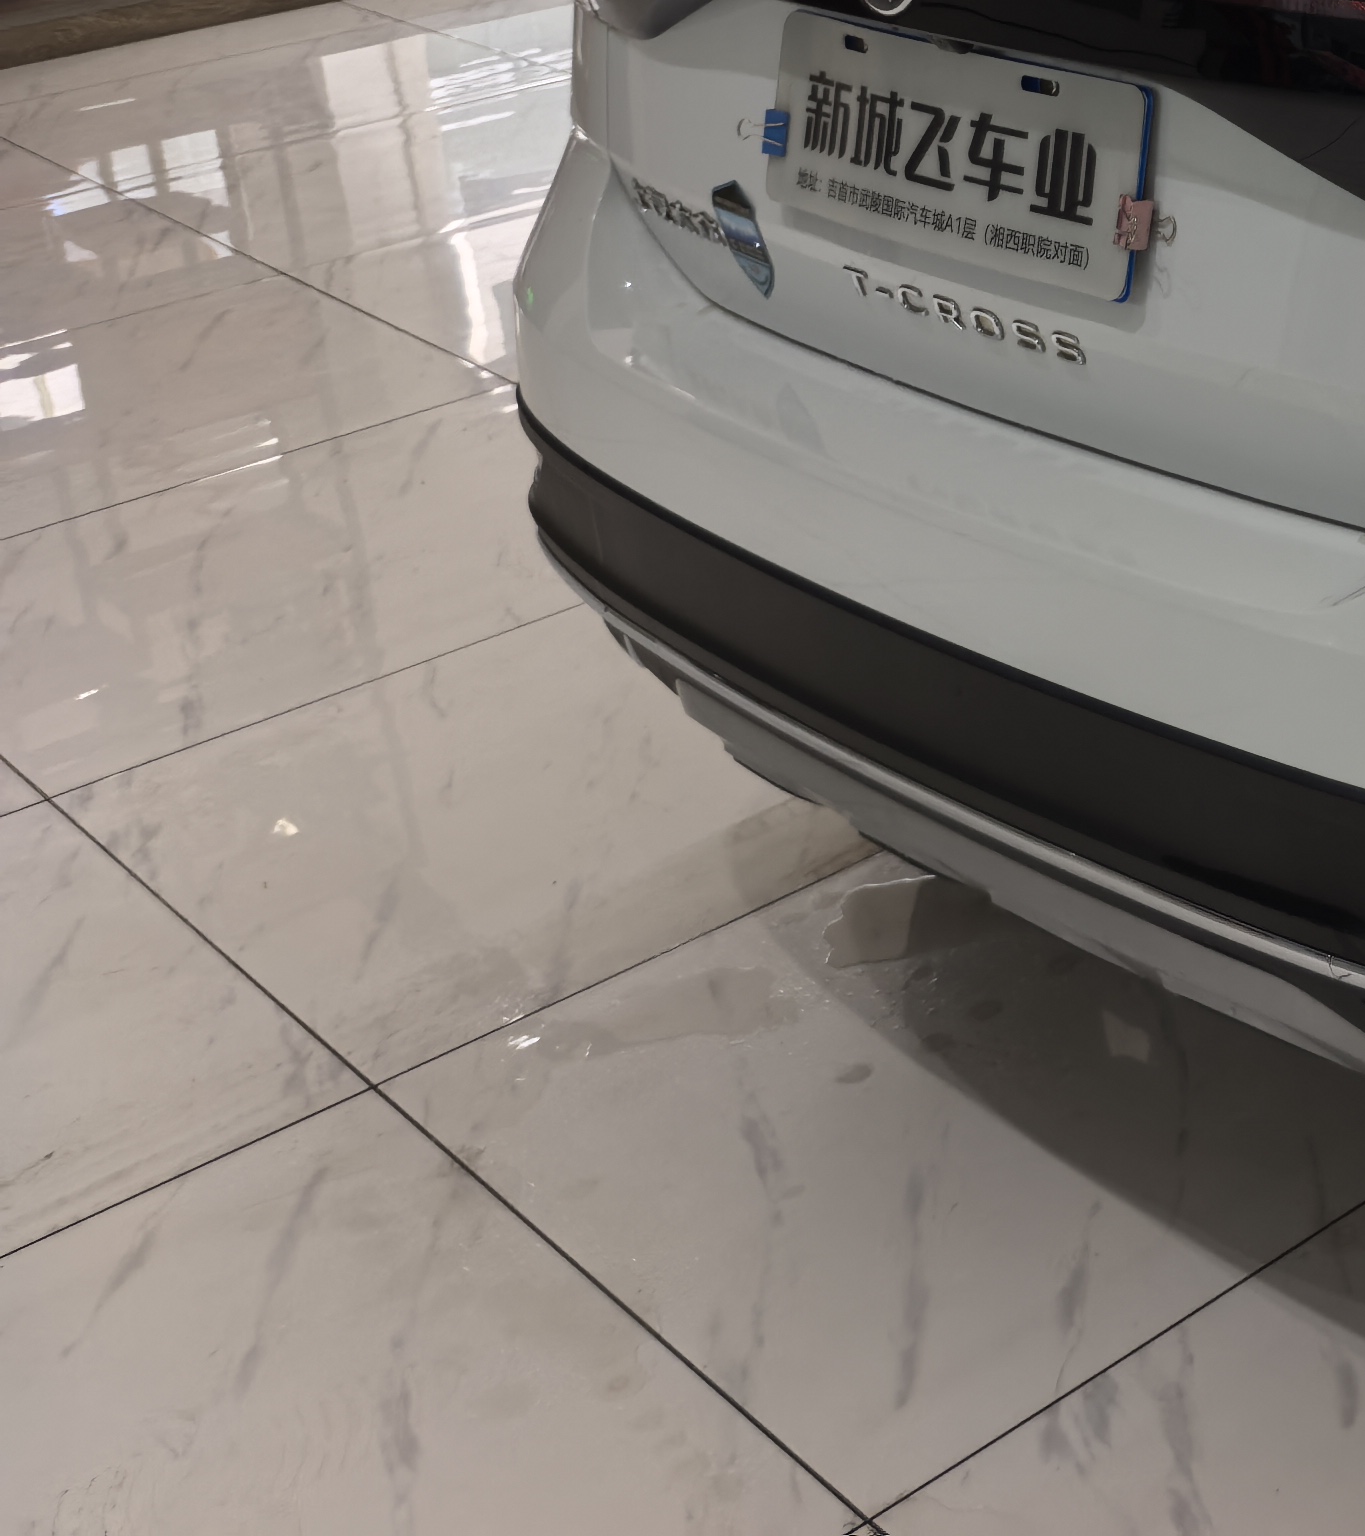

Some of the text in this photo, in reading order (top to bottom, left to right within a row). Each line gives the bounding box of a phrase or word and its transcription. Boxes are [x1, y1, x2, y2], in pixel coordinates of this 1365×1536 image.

[803, 71, 1097, 226] 新城飞车业
[842, 264, 1087, 365] T-CROSS
